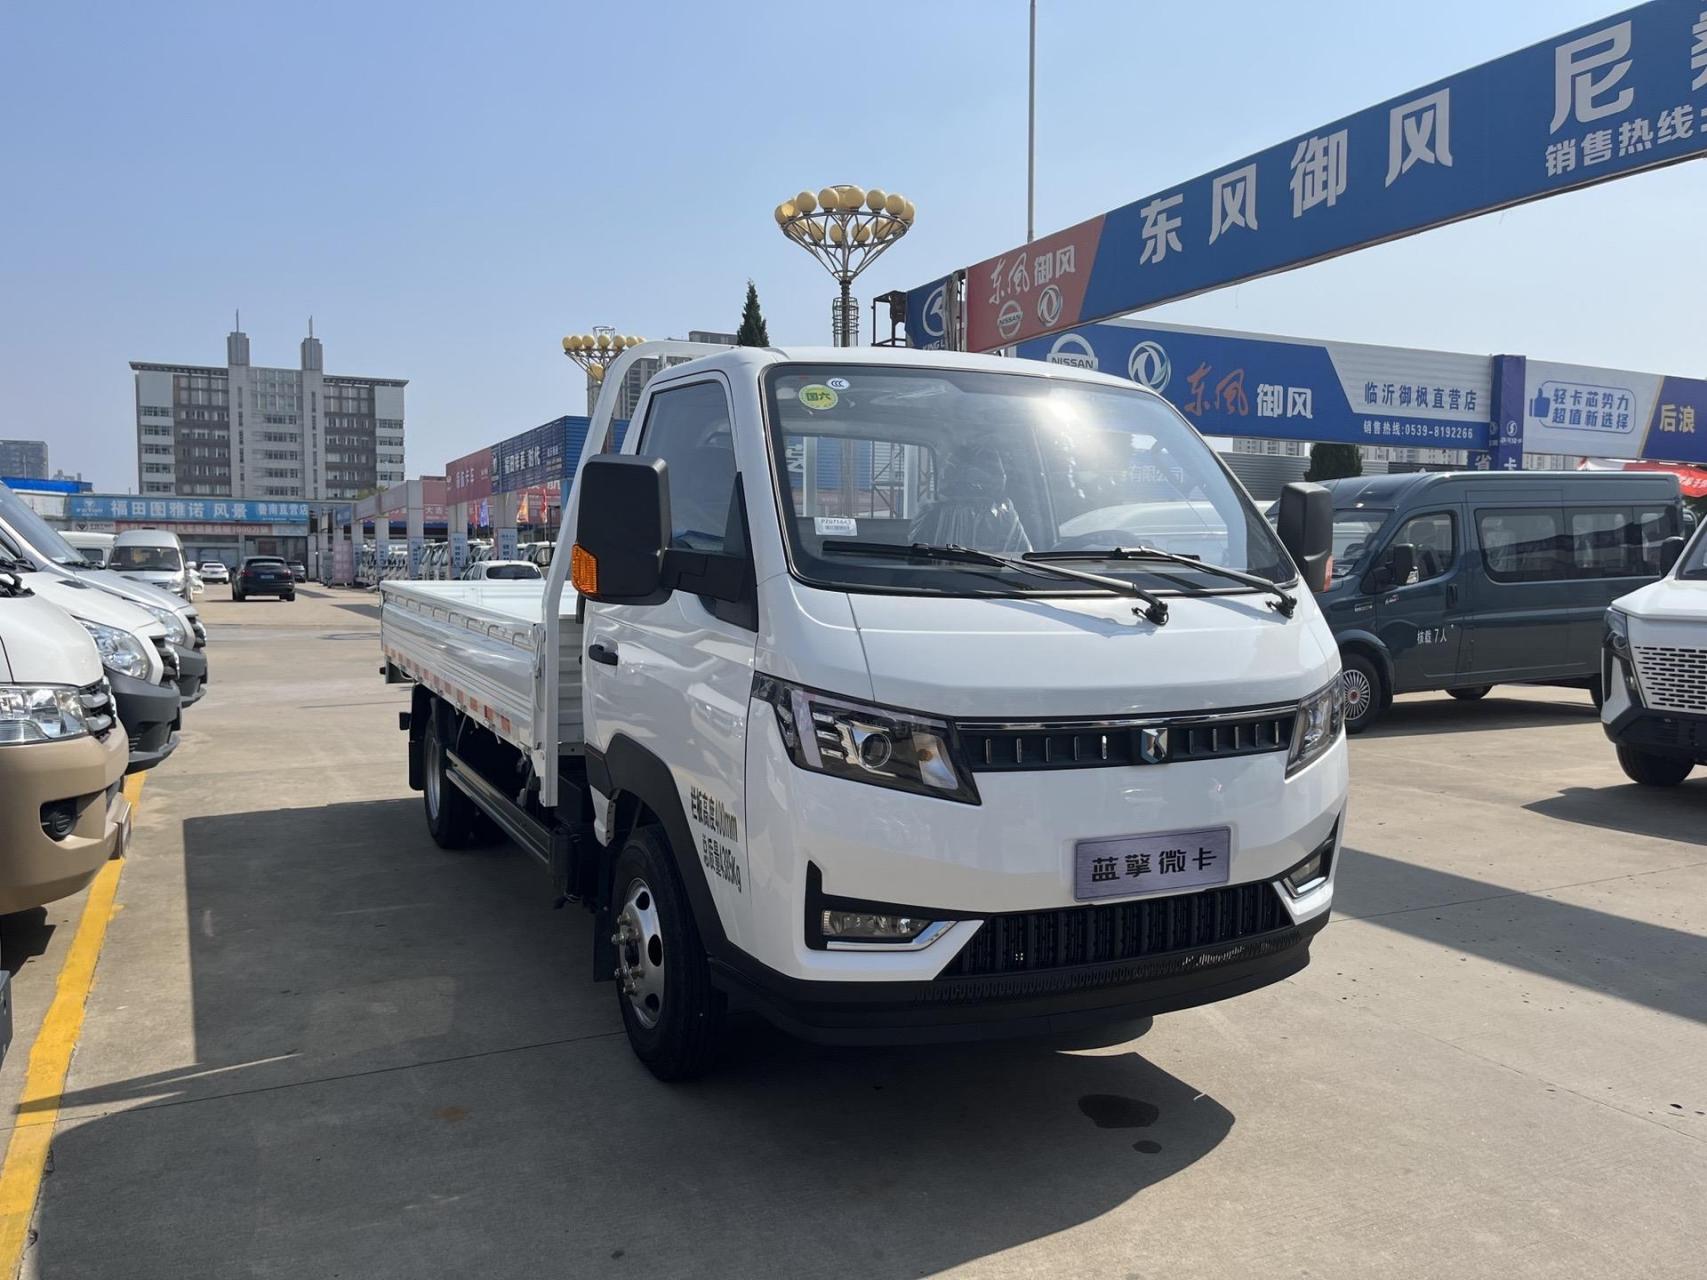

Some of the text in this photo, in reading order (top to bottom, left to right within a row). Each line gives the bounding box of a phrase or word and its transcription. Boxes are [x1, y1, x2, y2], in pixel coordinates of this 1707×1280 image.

[1546, 104, 1707, 177] 销售热线
[1051, 357, 1094, 369] NISSAN
[1364, 381, 1477, 411] 临沂御枫直营店
[1553, 387, 1629, 411] 轻卡芯势力
[1552, 407, 1629, 430] 超值新选择
[1659, 404, 1696, 434] 后浪
[1091, 847, 1217, 883] 蓝擎微卡
